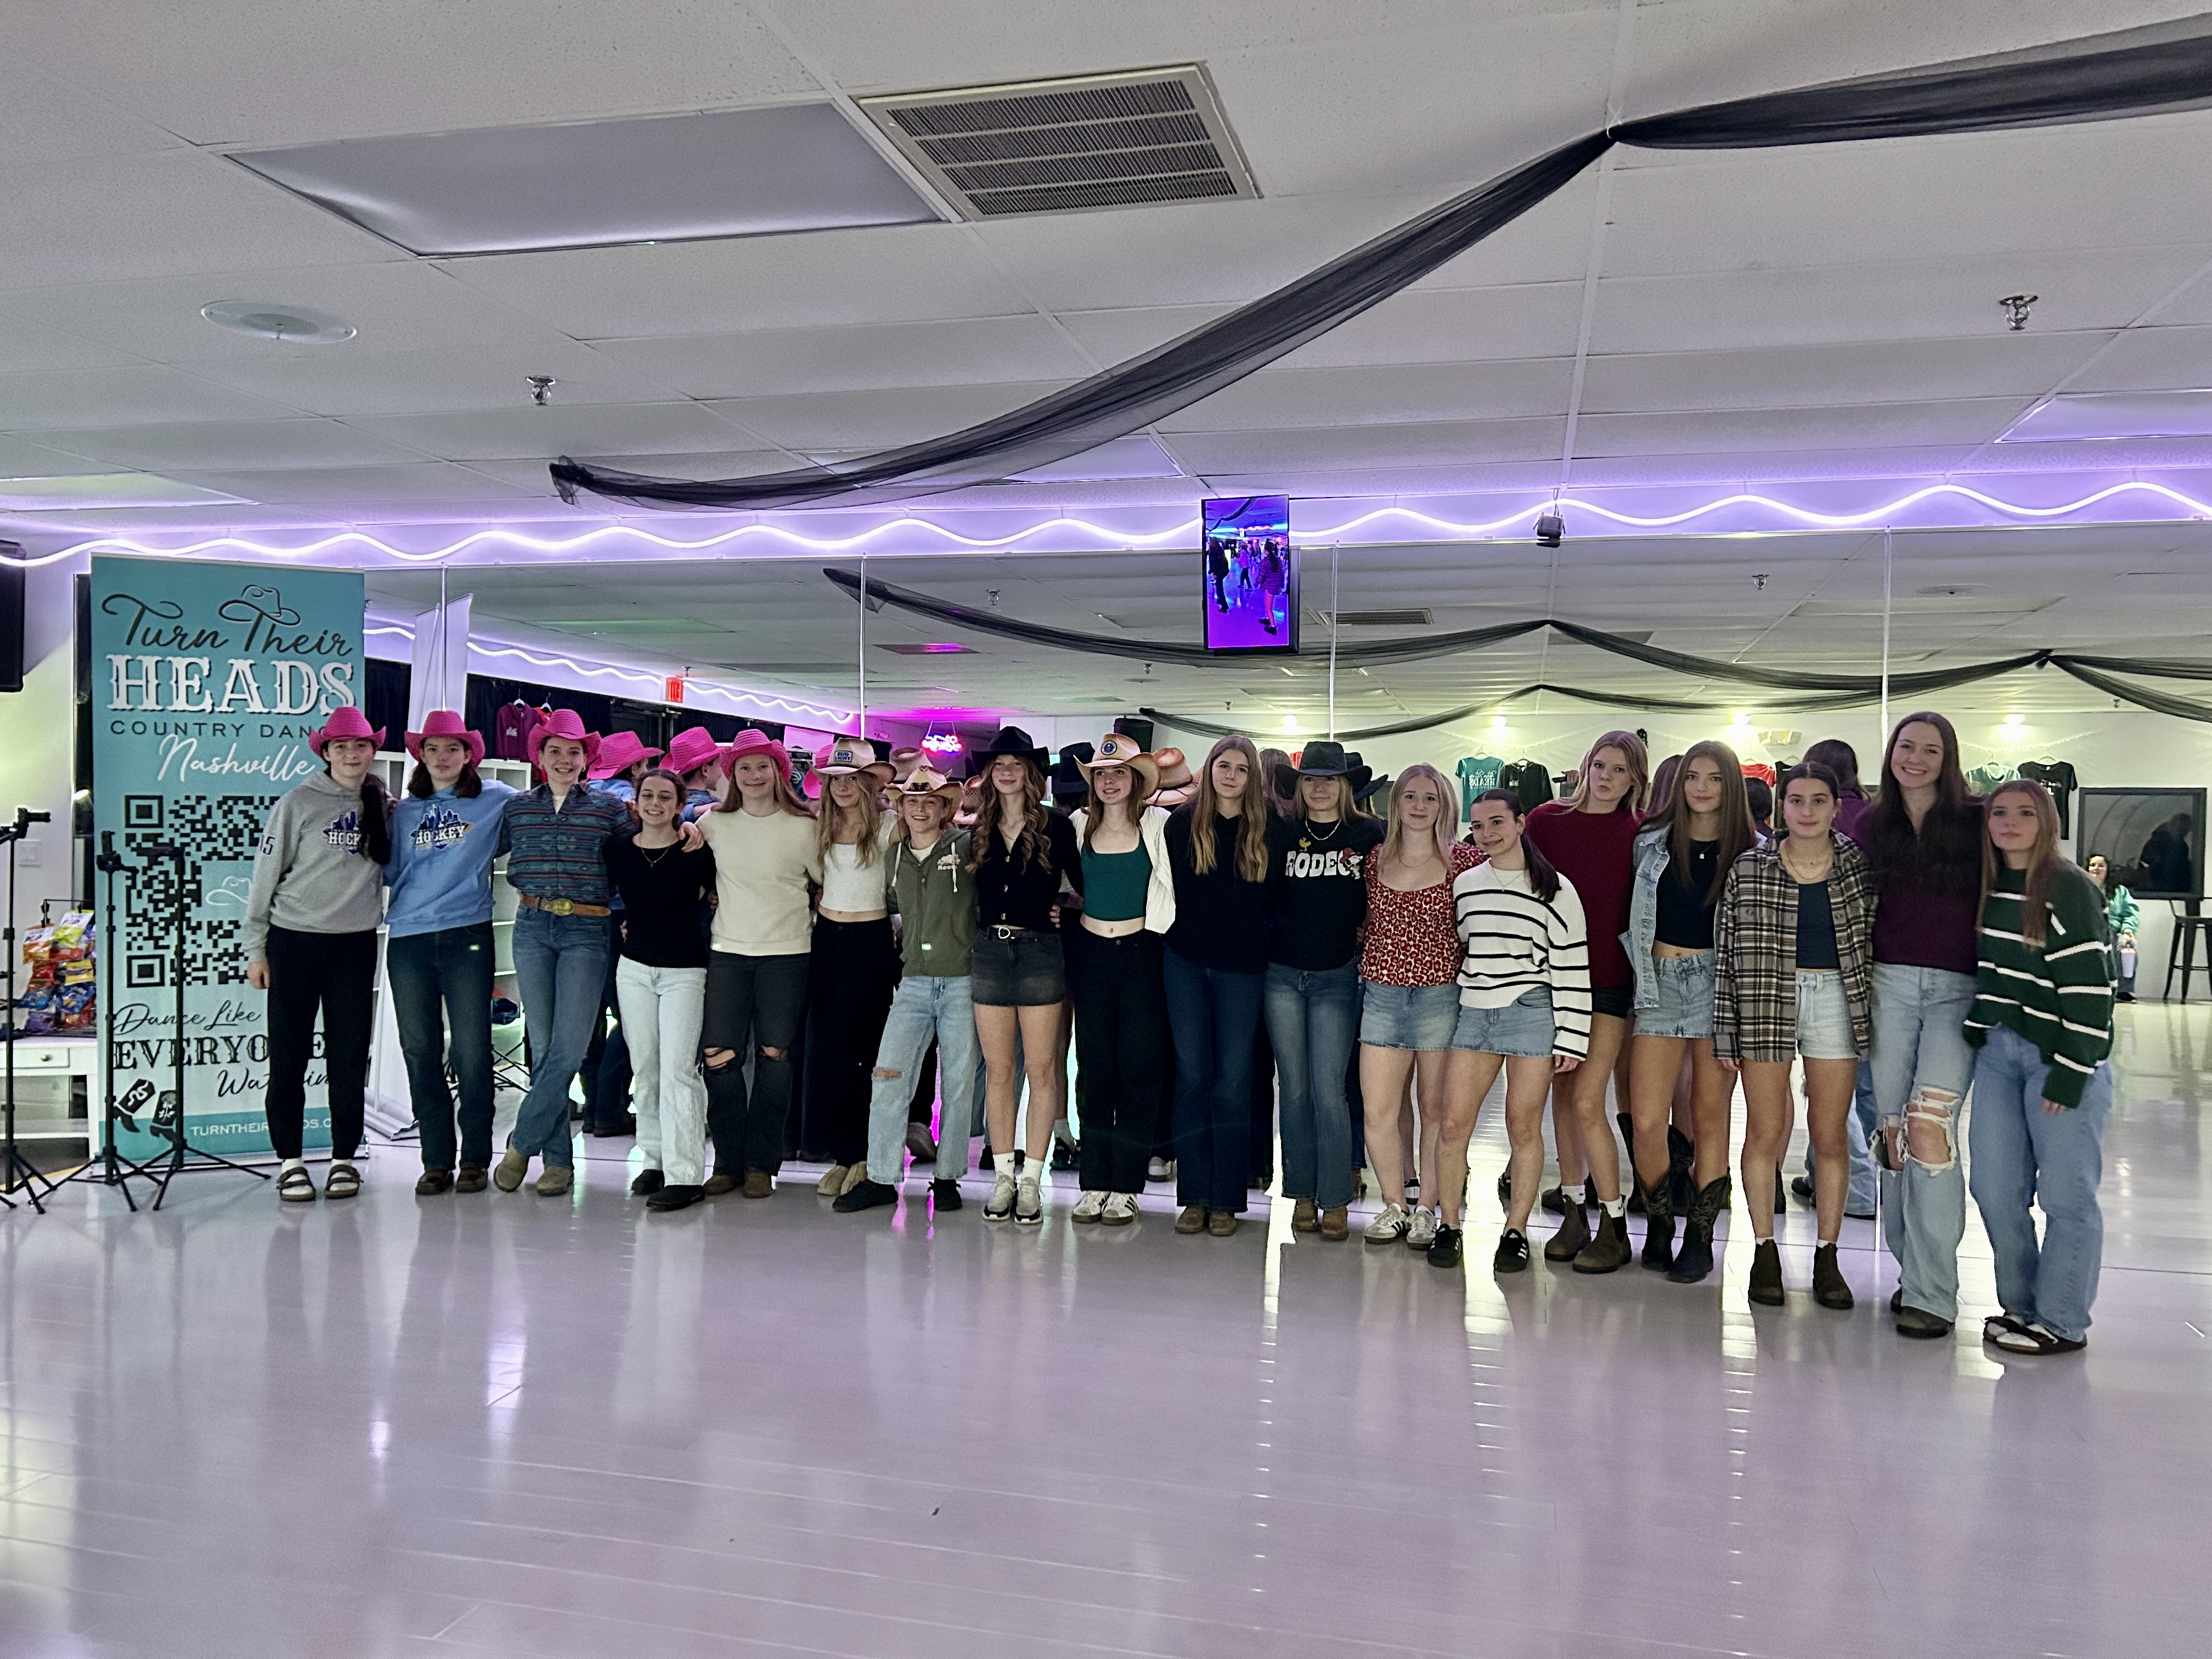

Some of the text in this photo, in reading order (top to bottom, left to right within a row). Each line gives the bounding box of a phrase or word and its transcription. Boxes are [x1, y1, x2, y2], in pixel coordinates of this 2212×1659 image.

[101, 594, 353, 657] Turn Their
[106, 654, 356, 716] HEADS
[110, 720, 326, 738] COUNTRY DAN
[157, 734, 315, 782] Nashville
[328, 831, 362, 845] HOCK
[415, 825, 465, 845] HOCKEY
[113, 1000, 261, 1036] Dance Like
[113, 1032, 326, 1070] EVERYOE
